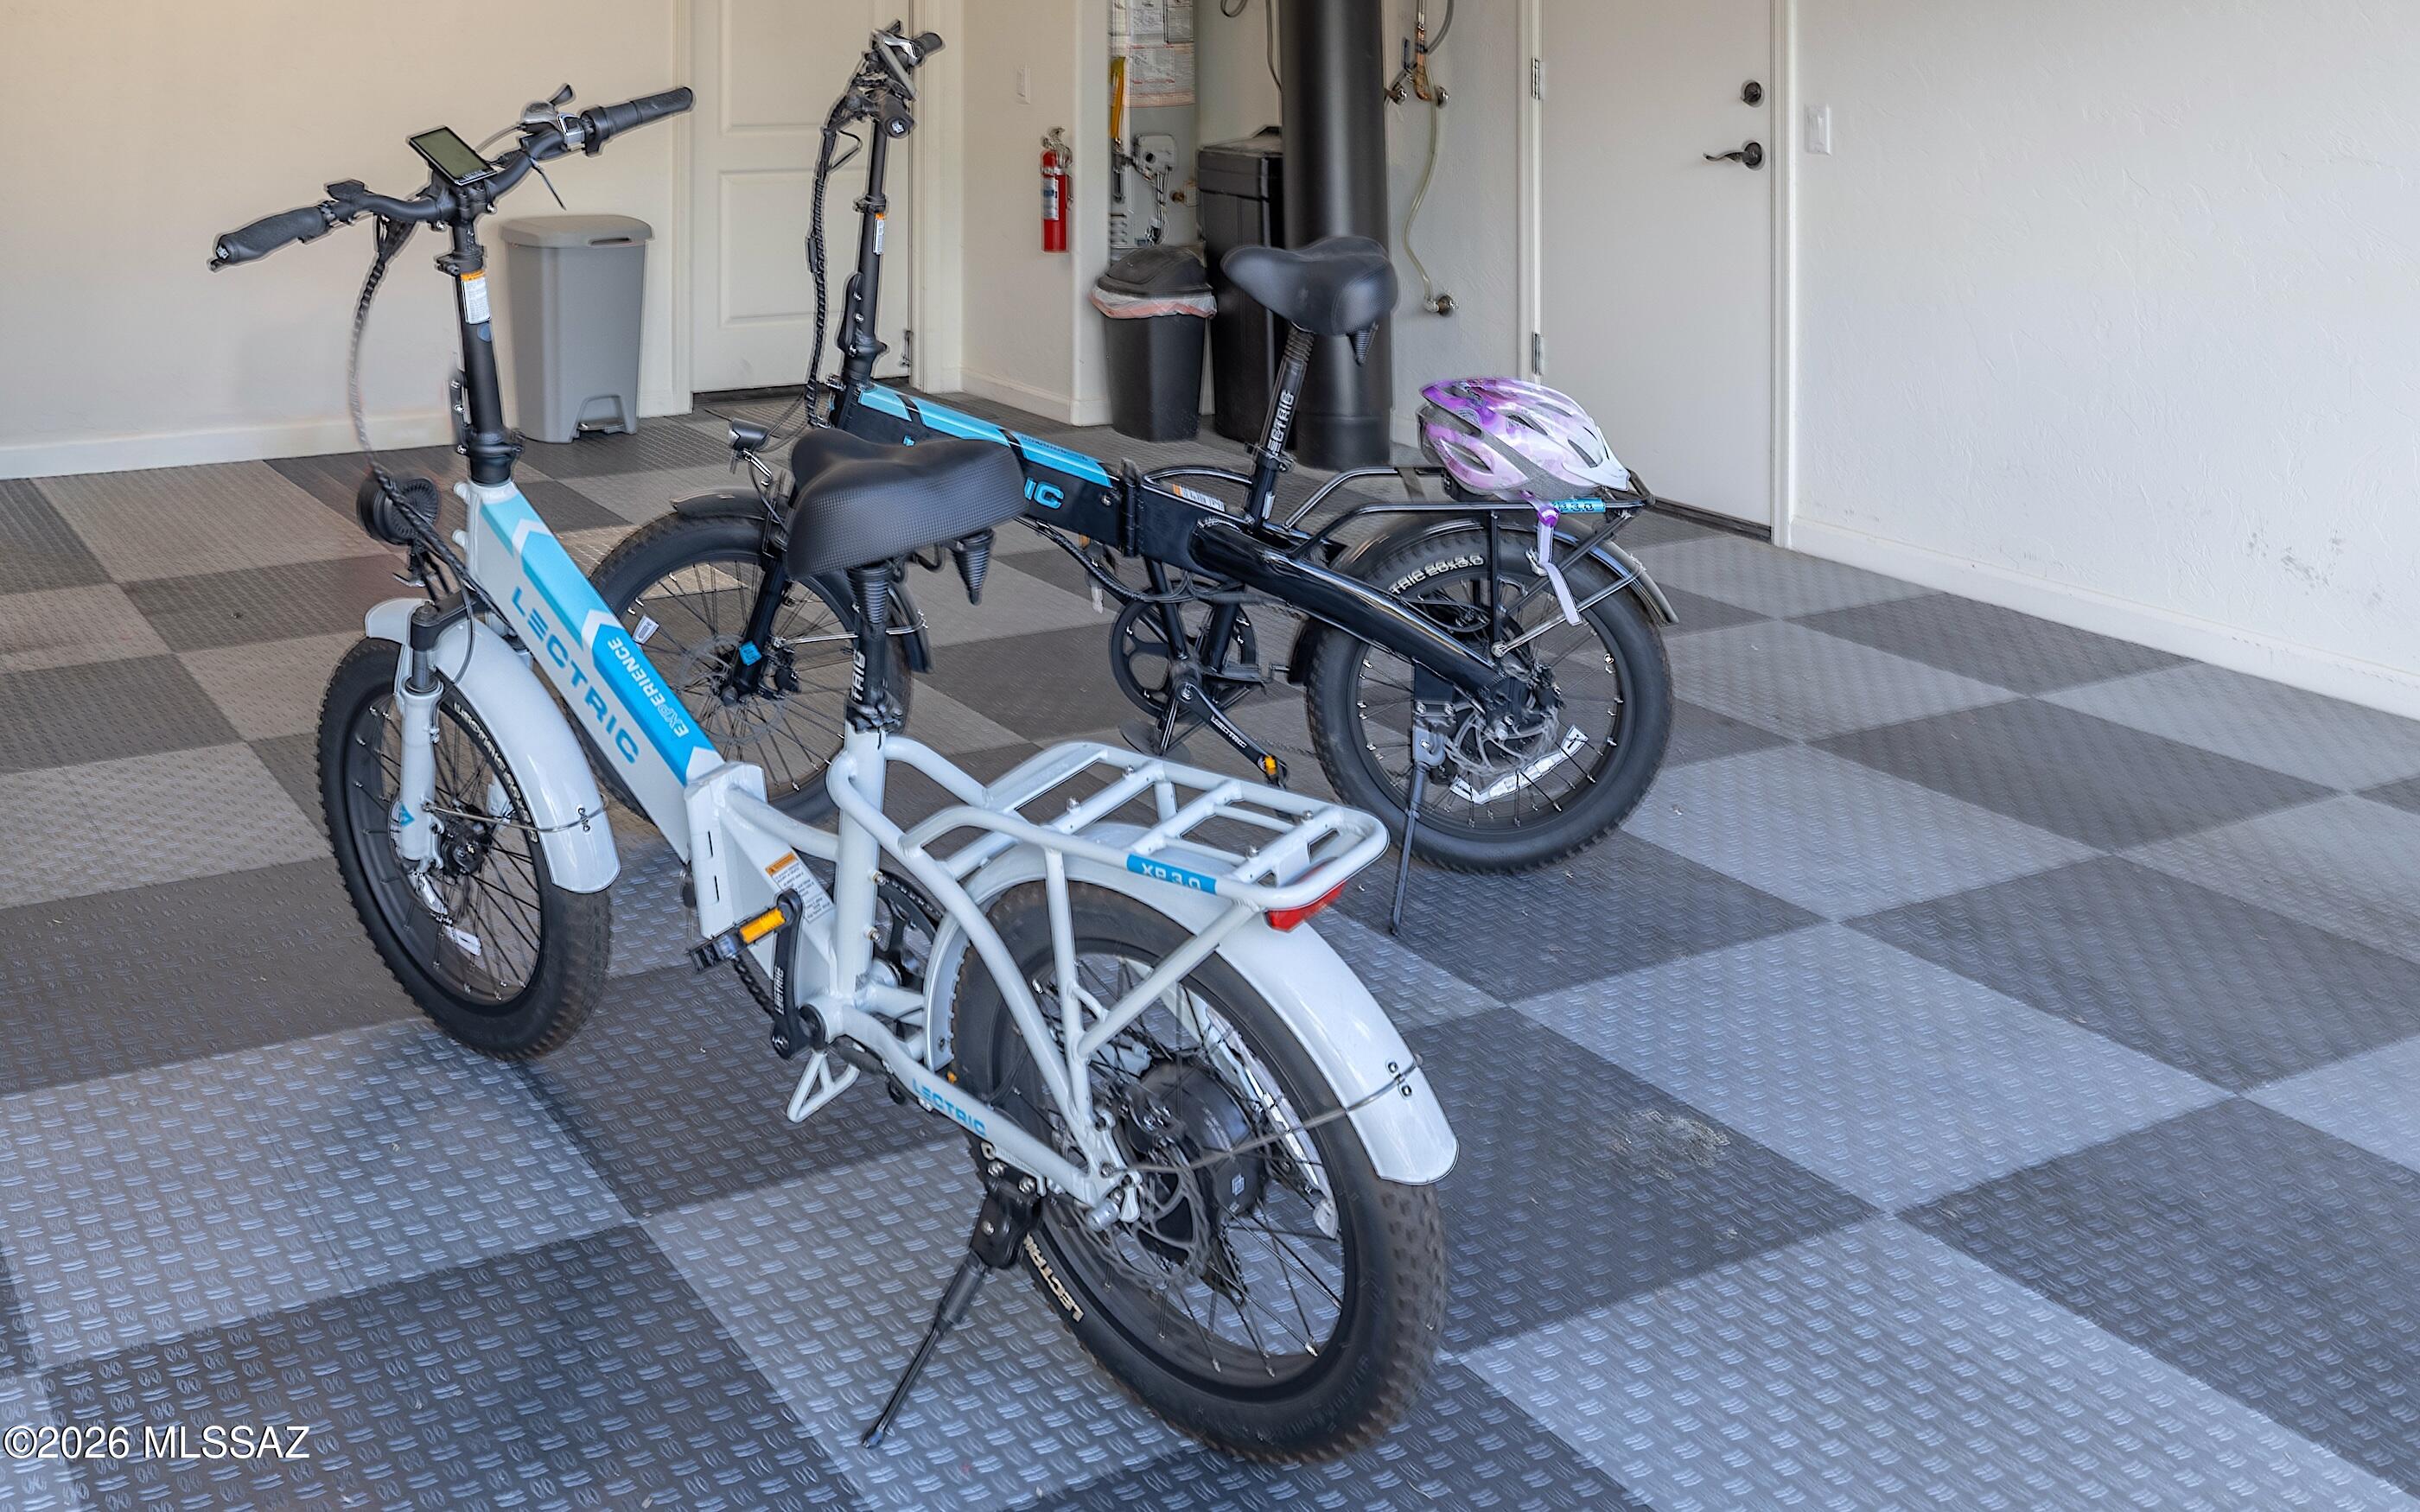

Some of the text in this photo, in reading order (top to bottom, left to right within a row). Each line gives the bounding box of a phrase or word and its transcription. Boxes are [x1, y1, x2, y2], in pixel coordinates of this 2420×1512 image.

[511, 586, 640, 765] LECTRIC
[608, 637, 691, 738] EXPERIENCE
[912, 1077, 987, 1137] LECTRIC
